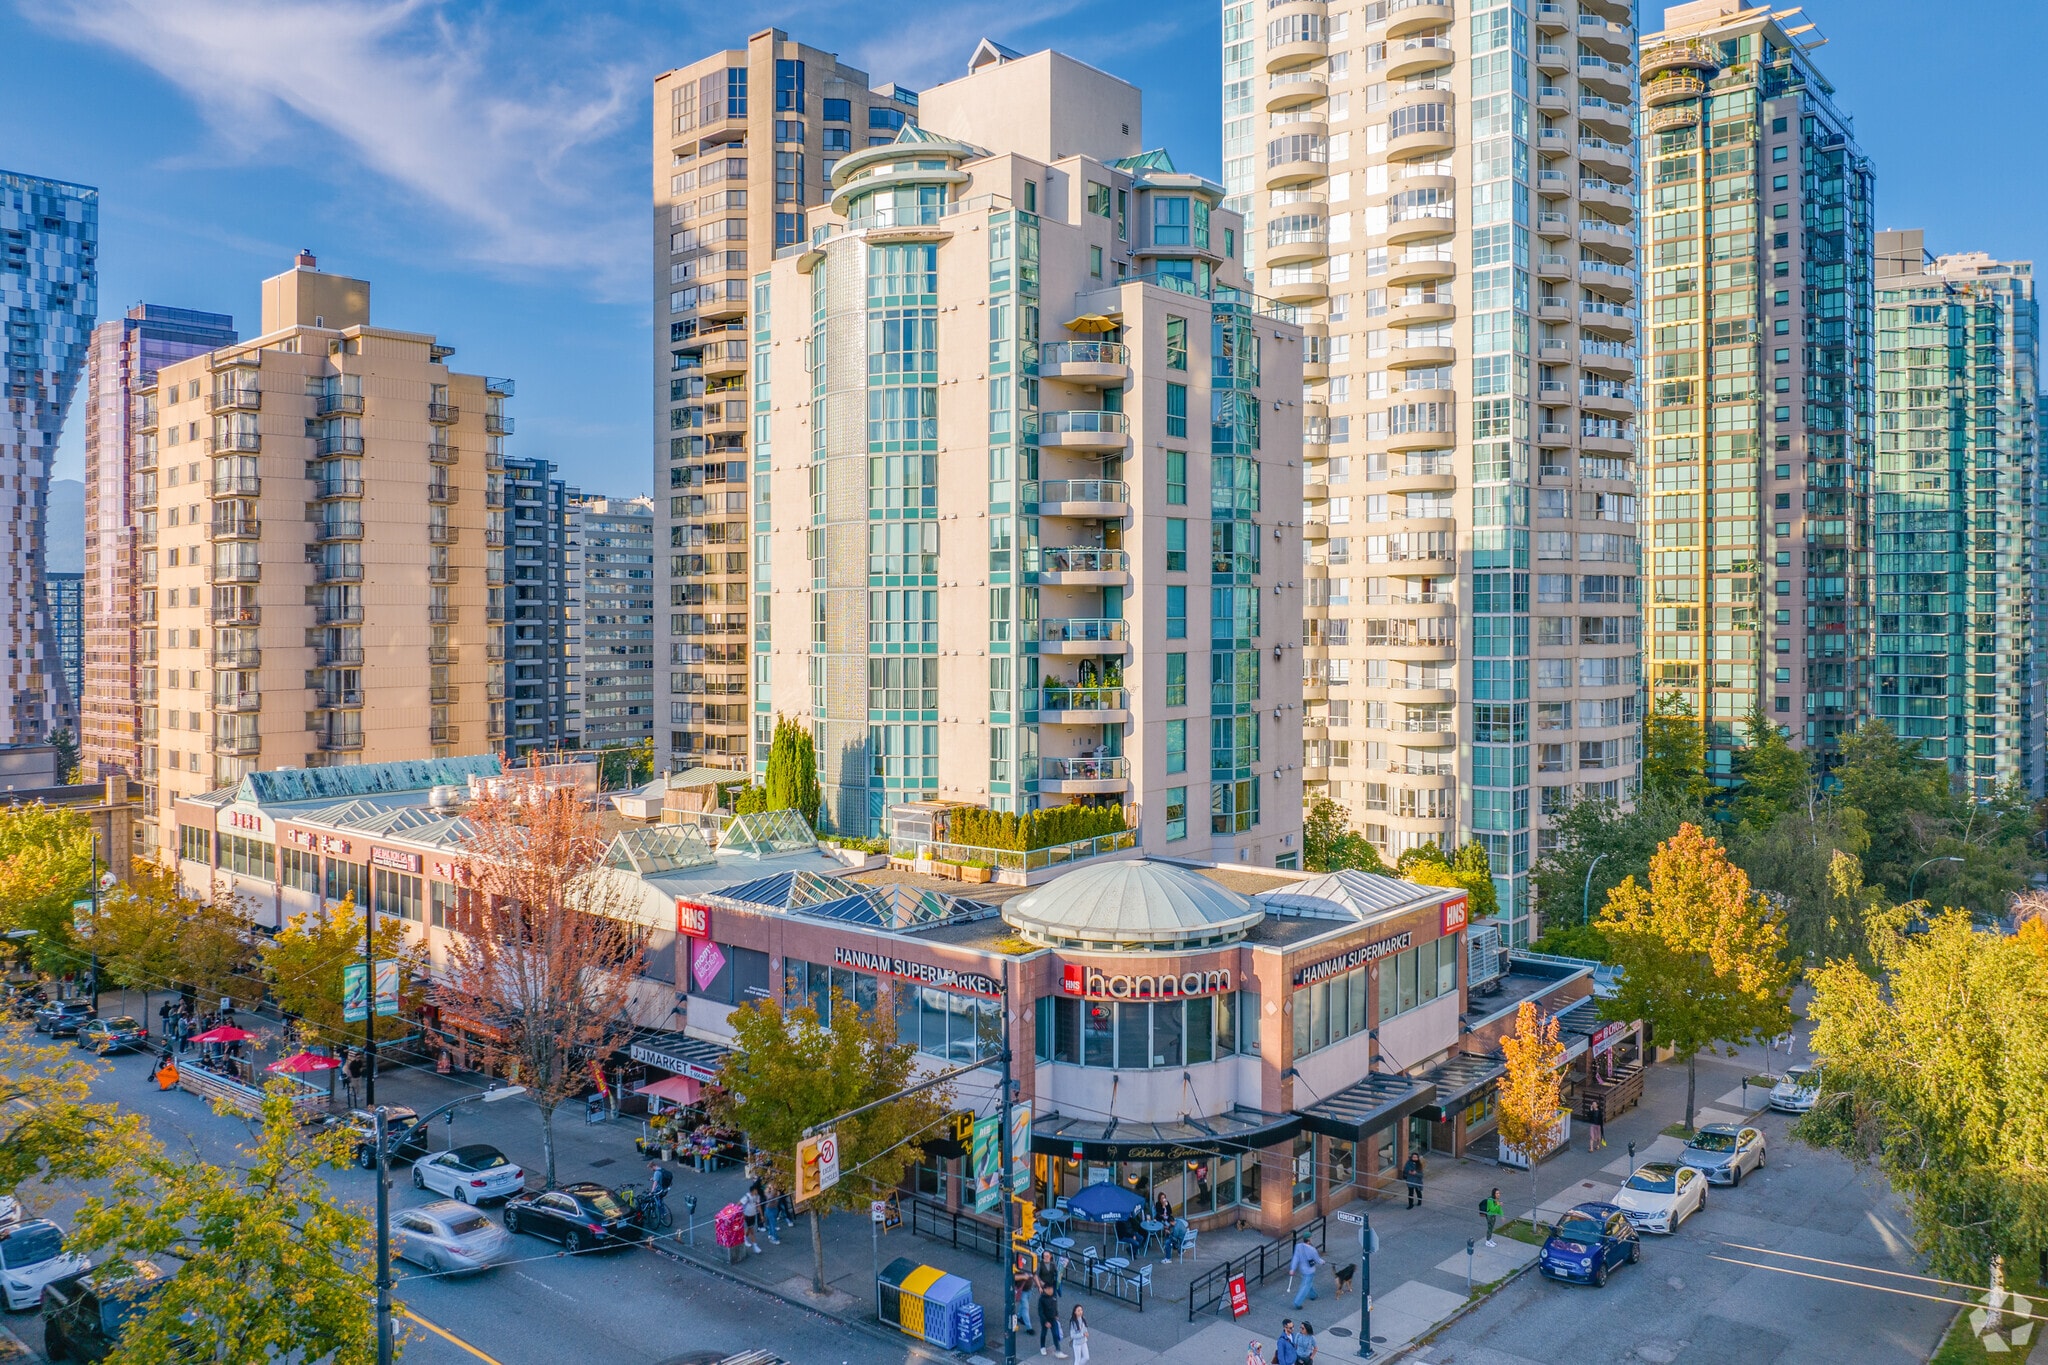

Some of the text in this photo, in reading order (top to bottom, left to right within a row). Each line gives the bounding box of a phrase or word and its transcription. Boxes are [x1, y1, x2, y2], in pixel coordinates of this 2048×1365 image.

[681, 906, 706, 931] HNS
[1446, 902, 1465, 927] HNS
[1303, 932, 1413, 985] HANNAM SUPERMARKET
[835, 947, 998, 995] HANNAM SUPERMARKET
[1086, 966, 1231, 998] hannam
[1065, 980, 1081, 990] HNS
[646, 1052, 688, 1075] MARKET
[960, 1114, 972, 1134] P
[1128, 1147, 1166, 1158] Bella
[821, 1171, 838, 1185] BICYCLES
[822, 1163, 836, 1176] EXCEPT
